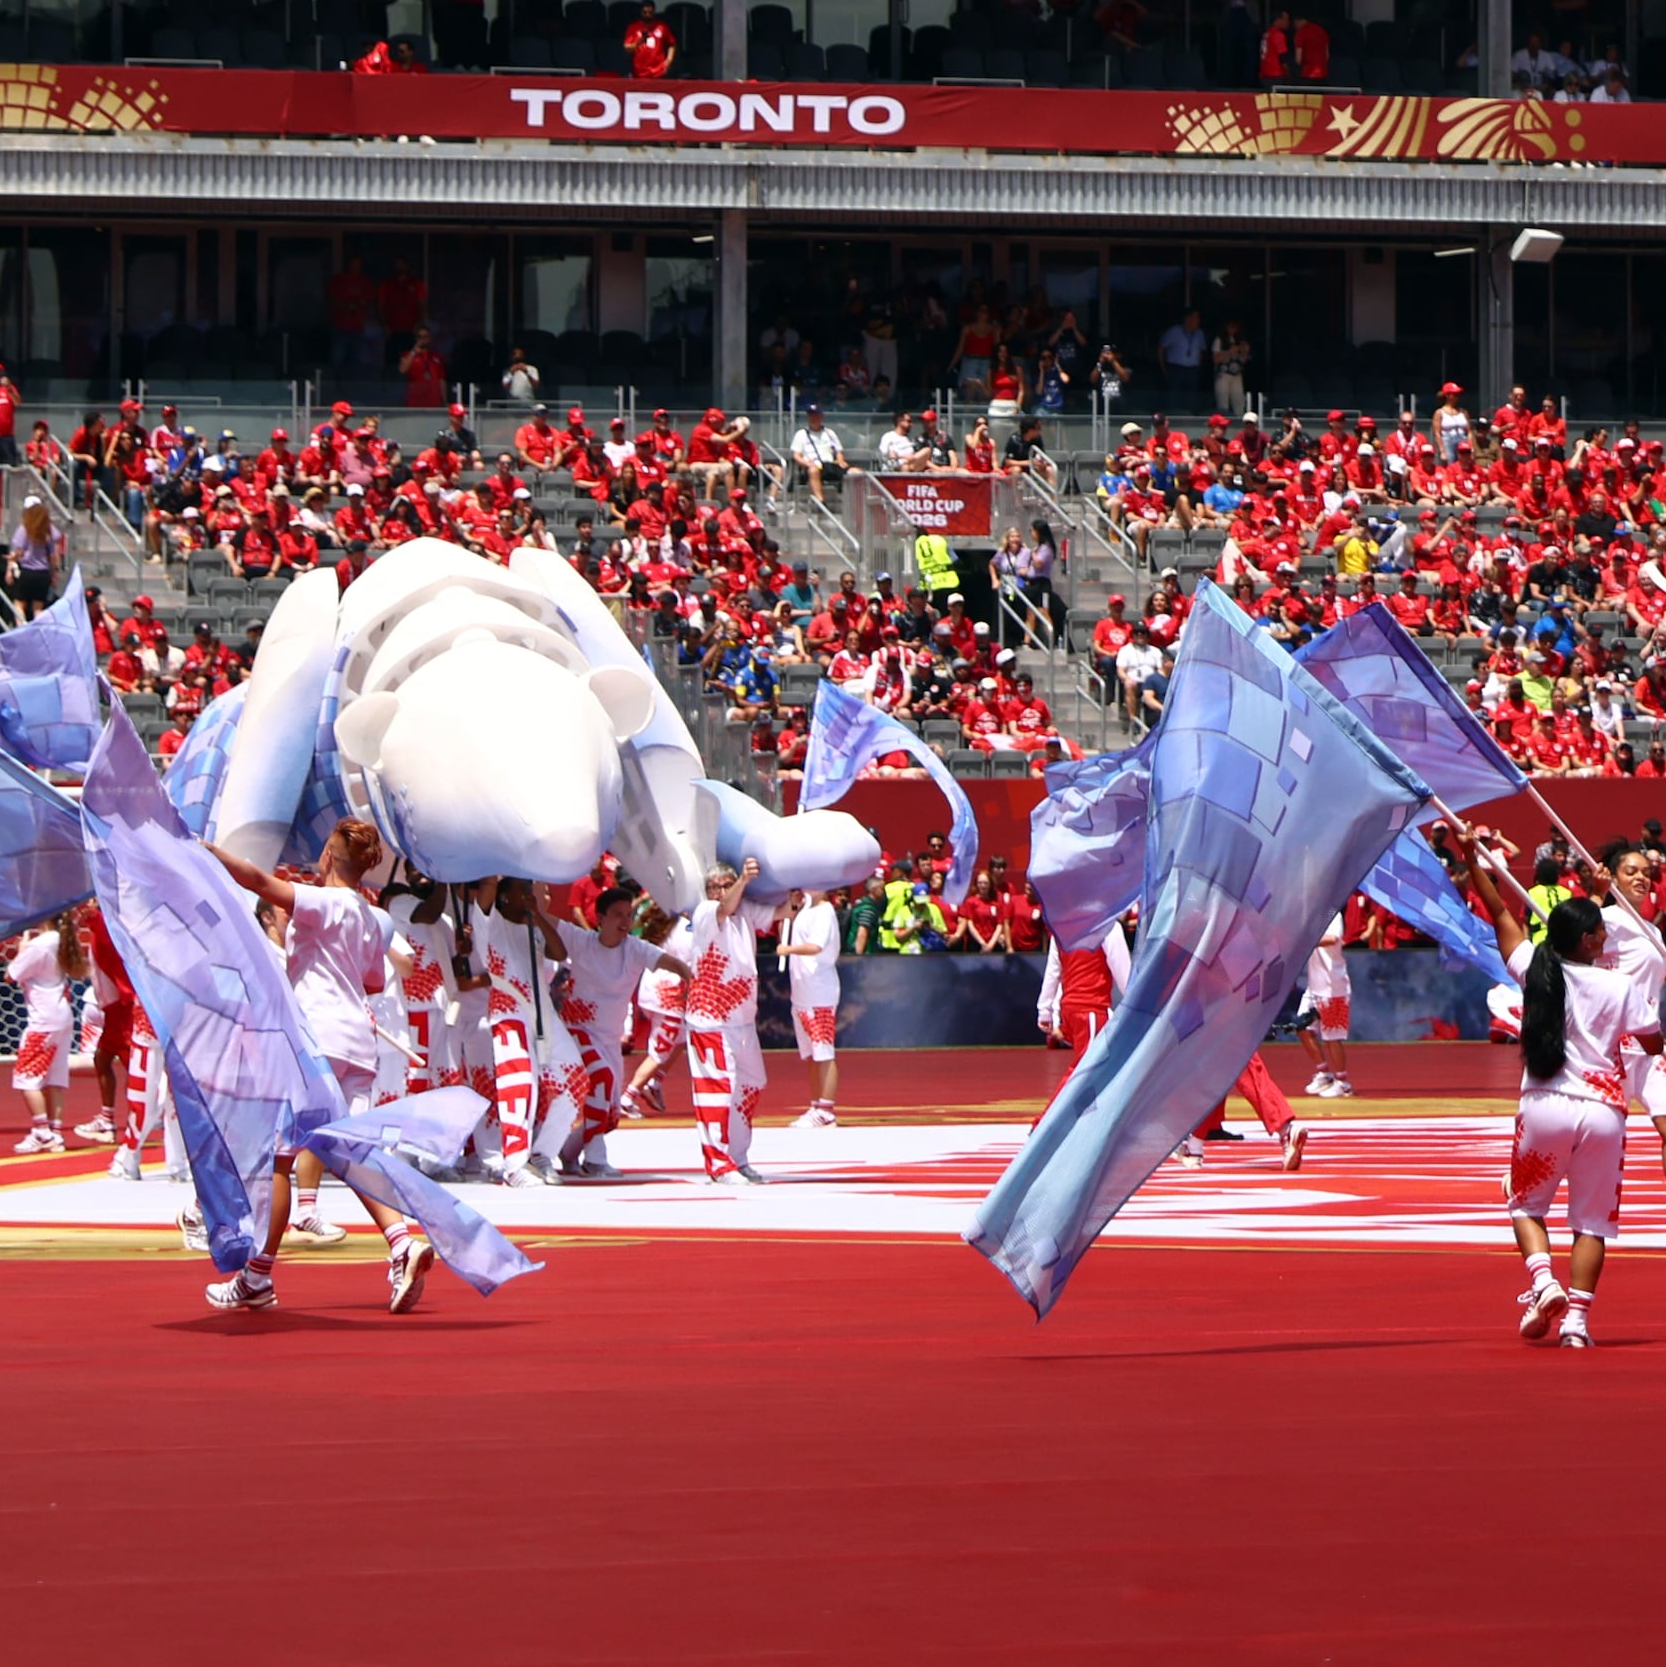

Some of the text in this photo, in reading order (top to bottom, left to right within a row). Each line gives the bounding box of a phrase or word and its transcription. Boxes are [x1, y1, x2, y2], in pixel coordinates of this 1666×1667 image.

[511, 89, 906, 135] TORONTO
[895, 499, 964, 513] ORLD CUP
[907, 485, 938, 498] FIFA
[911, 514, 948, 527] 026
[491, 1019, 533, 1157] FIFA
[690, 1031, 739, 1177] FIFA
